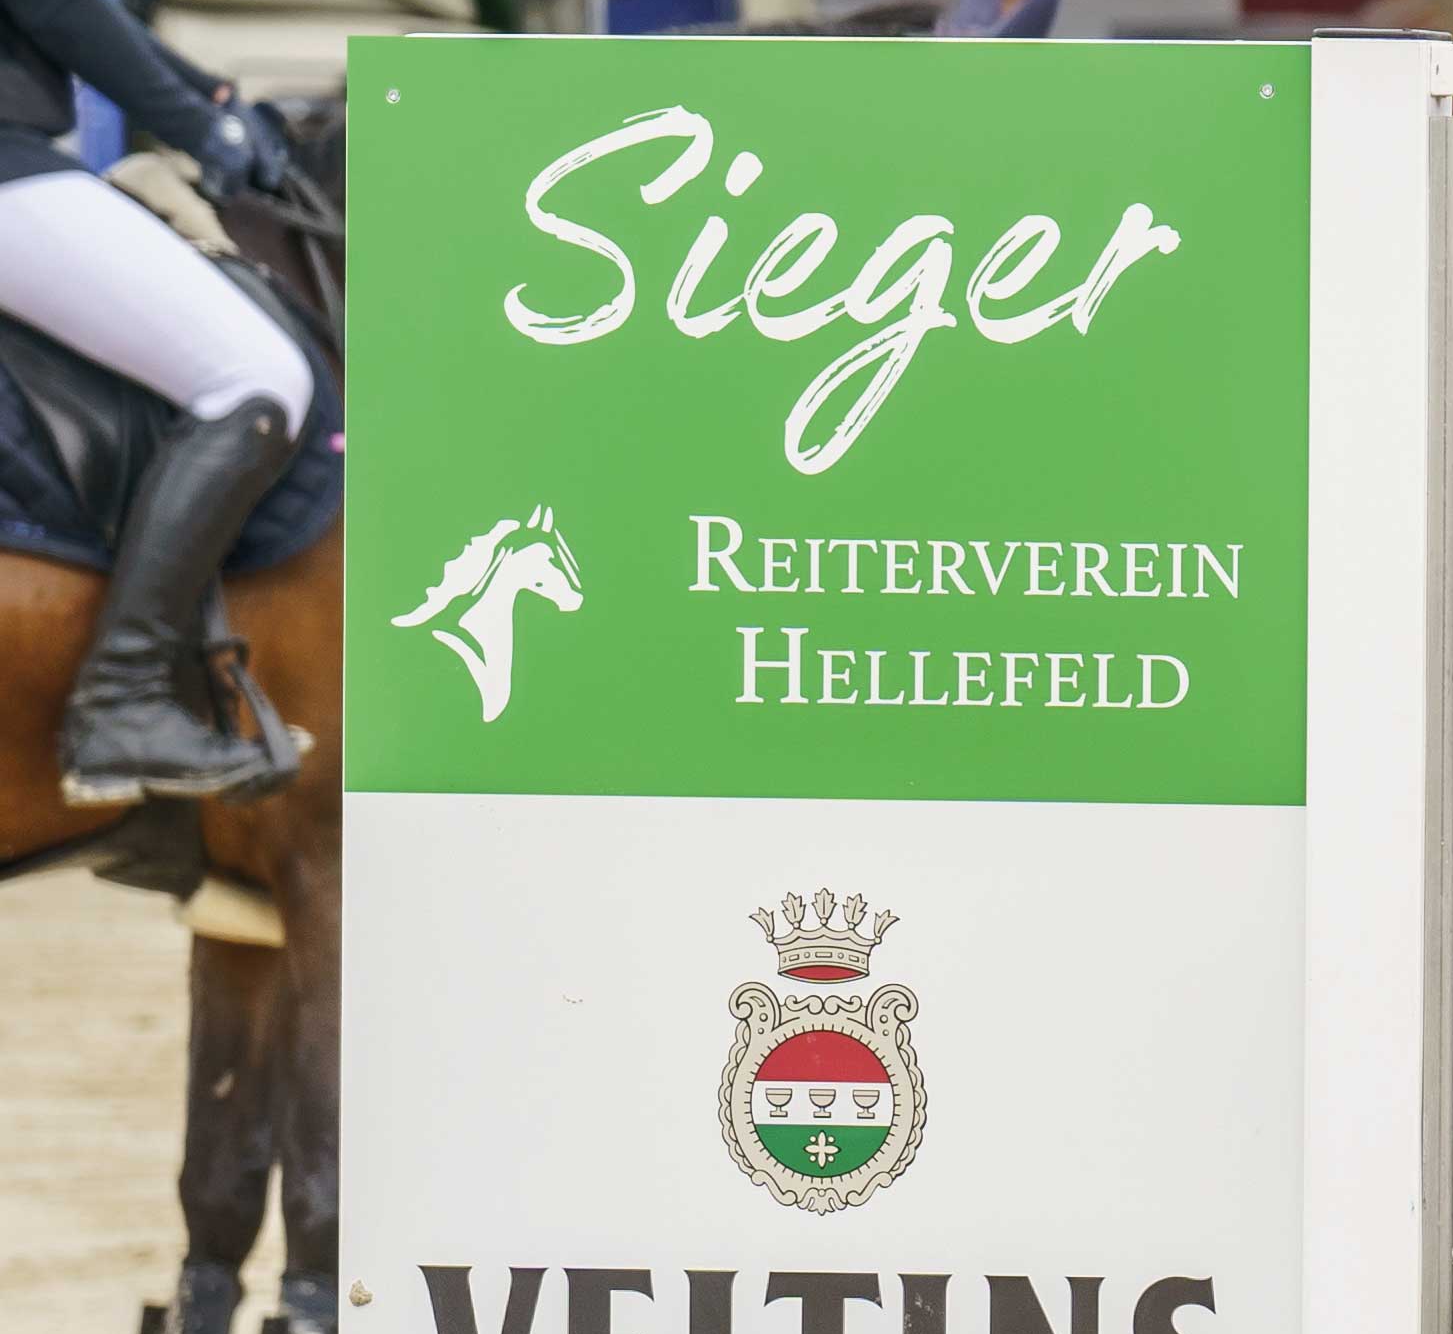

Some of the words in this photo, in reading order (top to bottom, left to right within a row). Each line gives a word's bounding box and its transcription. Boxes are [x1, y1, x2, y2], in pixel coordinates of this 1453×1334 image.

[504, 105, 1181, 474] Sieger
[689, 516, 1243, 598] REITERVEREIN
[736, 627, 1189, 707] HELLEFELD
